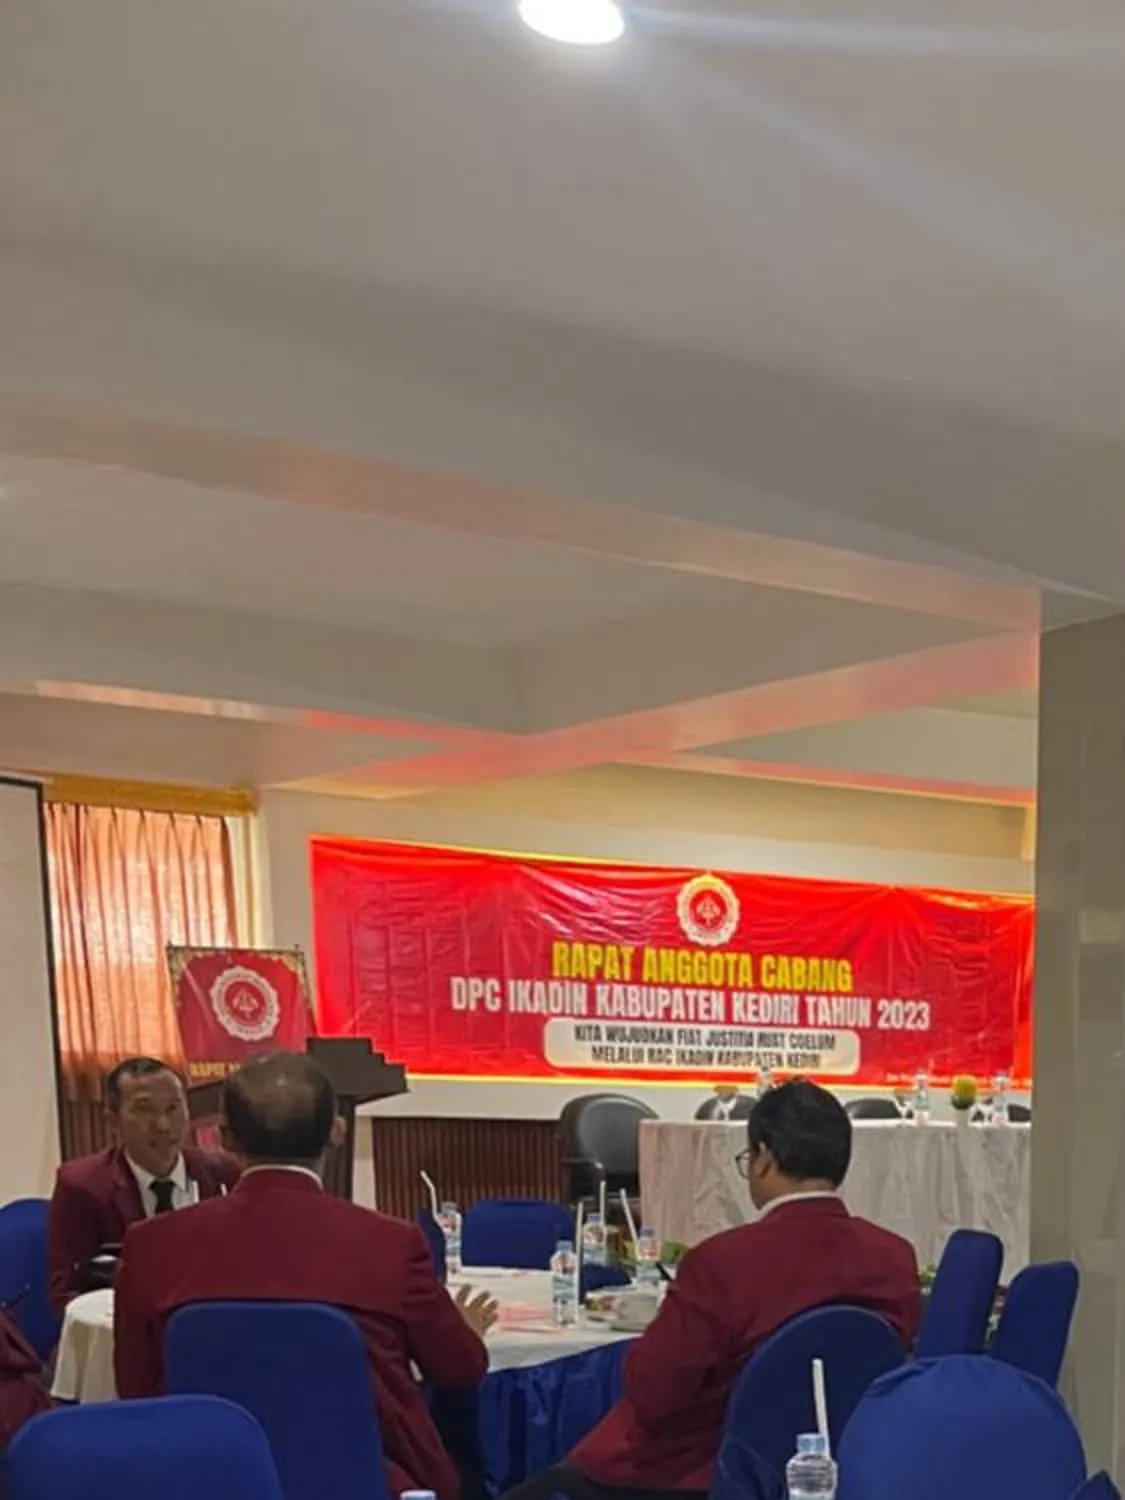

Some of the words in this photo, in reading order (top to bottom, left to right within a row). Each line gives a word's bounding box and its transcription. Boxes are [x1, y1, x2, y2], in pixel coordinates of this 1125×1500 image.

[552, 941, 634, 981] RAPAT
[643, 946, 753, 987] ANGGOTA
[761, 953, 854, 992] CABANG
[451, 976, 501, 1012] DPC
[508, 978, 587, 1016] IKADIN
[596, 983, 725, 1022] KABUPATEN
[732, 991, 800, 1025] KEDIRI
[805, 994, 872, 1028] TAHUN
[876, 999, 930, 1031] 2023
[574, 1024, 602, 1041] KITA
[605, 1026, 674, 1044] WUJUDKAN
[677, 1028, 701, 1045] FIAT
